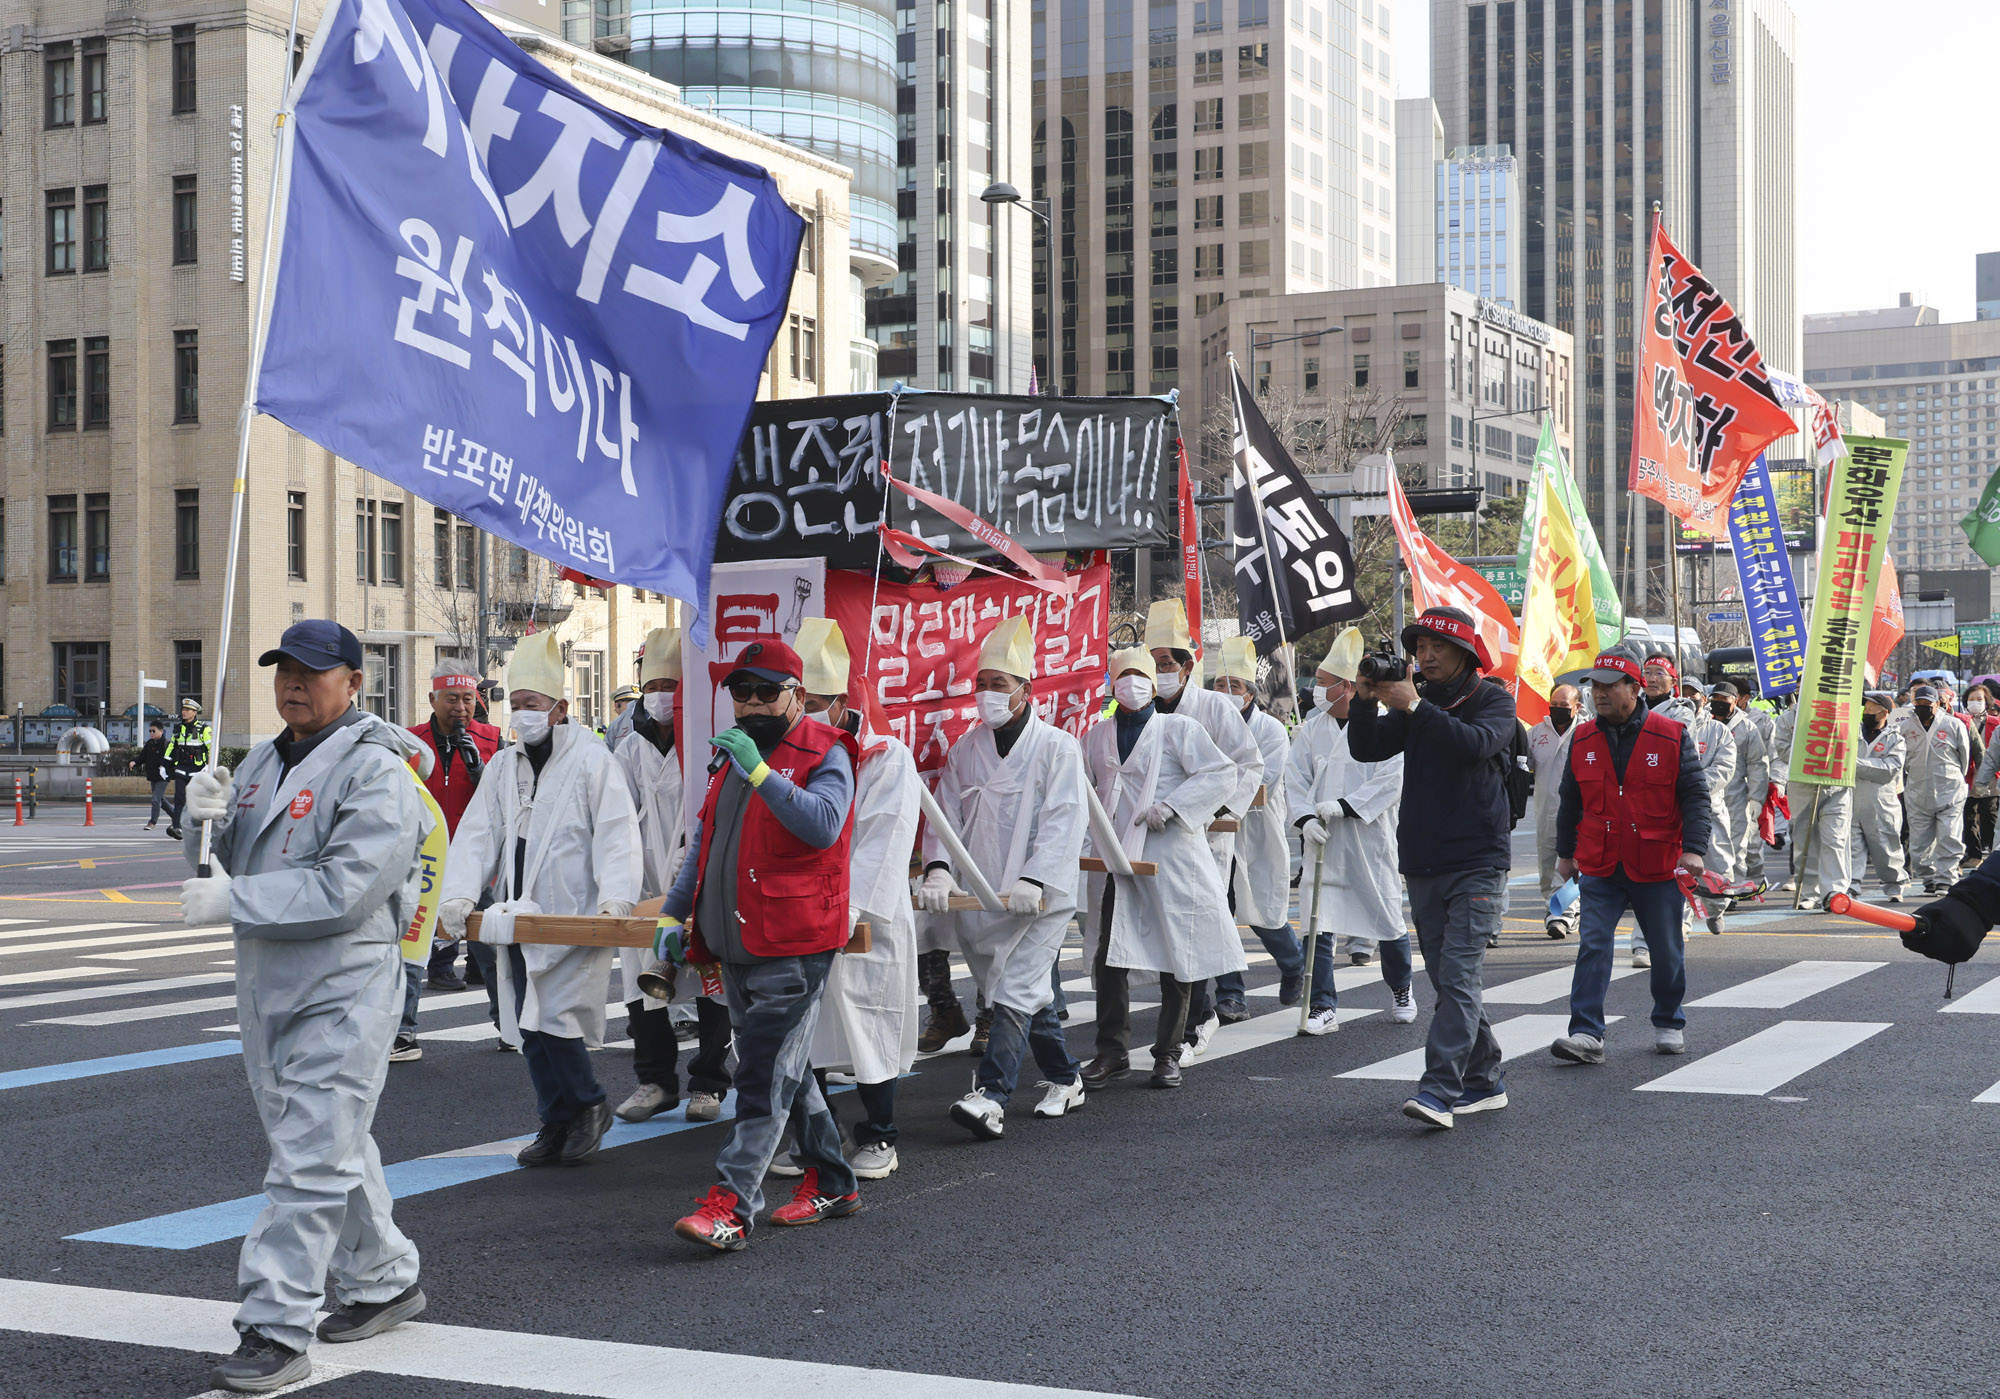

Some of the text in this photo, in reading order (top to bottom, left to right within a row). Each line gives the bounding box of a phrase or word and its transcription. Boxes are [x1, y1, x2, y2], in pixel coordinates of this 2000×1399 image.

[229, 104, 243, 129] art
[229, 131, 243, 151] of
[231, 156, 243, 233] museum
[1491, 305, 1512, 328] SEOUL
[394, 217, 639, 498] 원칙이다
[422, 423, 616, 574] 반포면 대책위원회
[1839, 446, 1893, 527] 문화유산
[1185, 543, 1197, 580] 결사반대
[1485, 571, 1507, 581] 종로
[1830, 531, 1877, 612] 파괴하는
[1594, 658, 1626, 669] 사반대
[1645, 657, 1672, 669] 사반대
[1585, 751, 1659, 767] 투 쟁
[237, 783, 261, 819] 주
